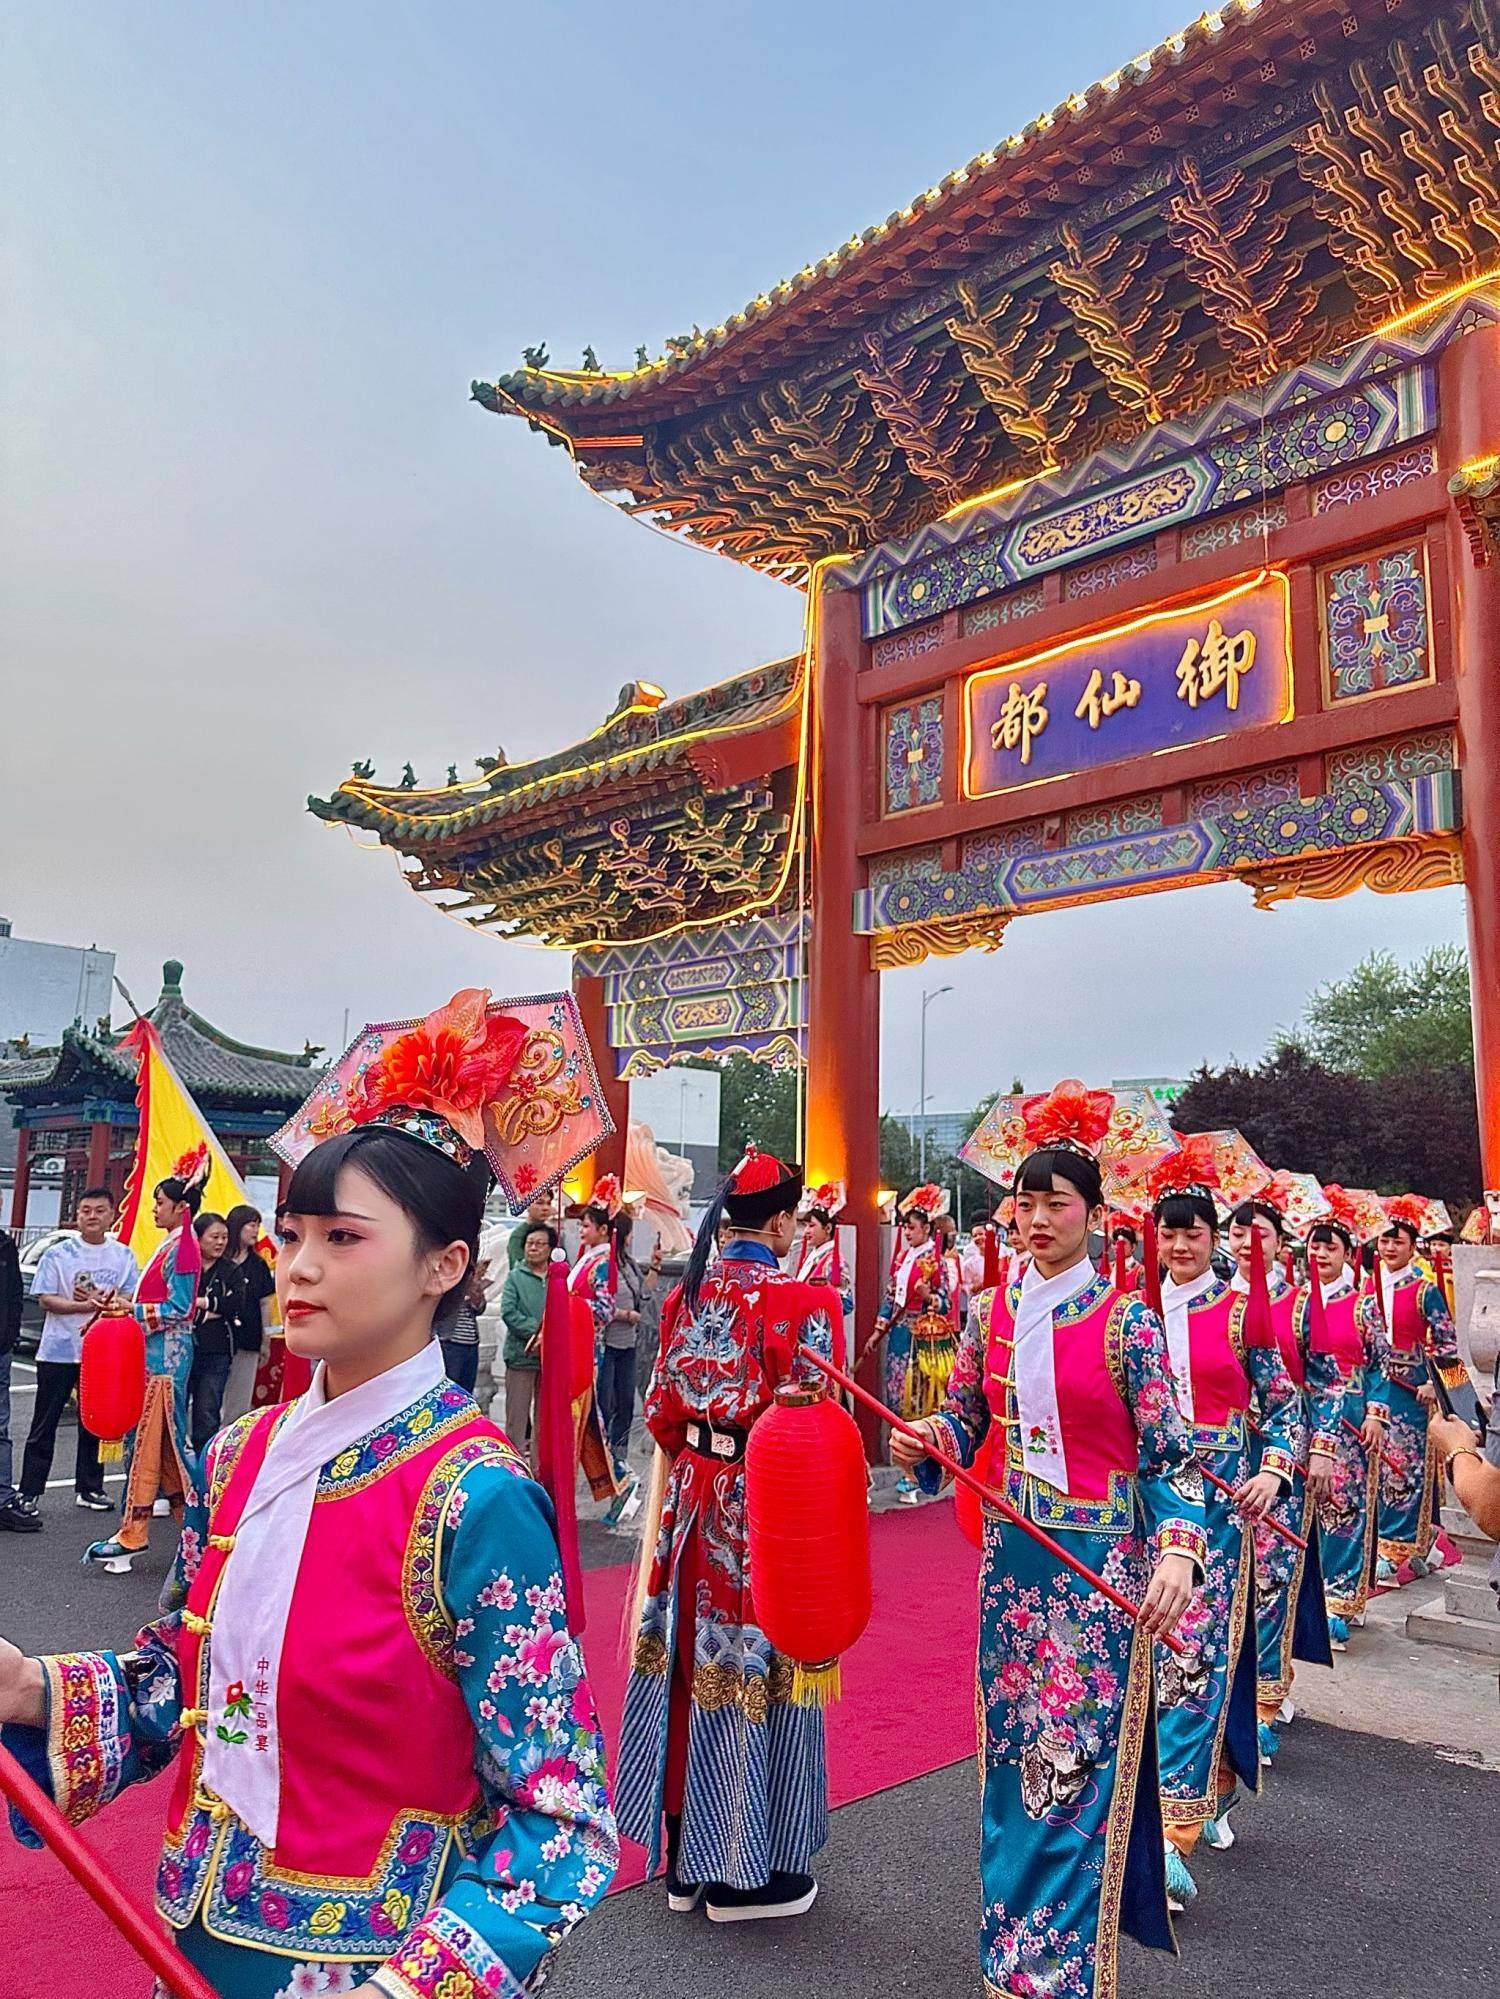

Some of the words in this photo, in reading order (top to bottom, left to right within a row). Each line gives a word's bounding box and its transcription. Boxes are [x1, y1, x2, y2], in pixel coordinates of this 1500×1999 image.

[990, 619, 1258, 765] 御仙都
[254, 1656, 270, 1752] 中华一品宴
